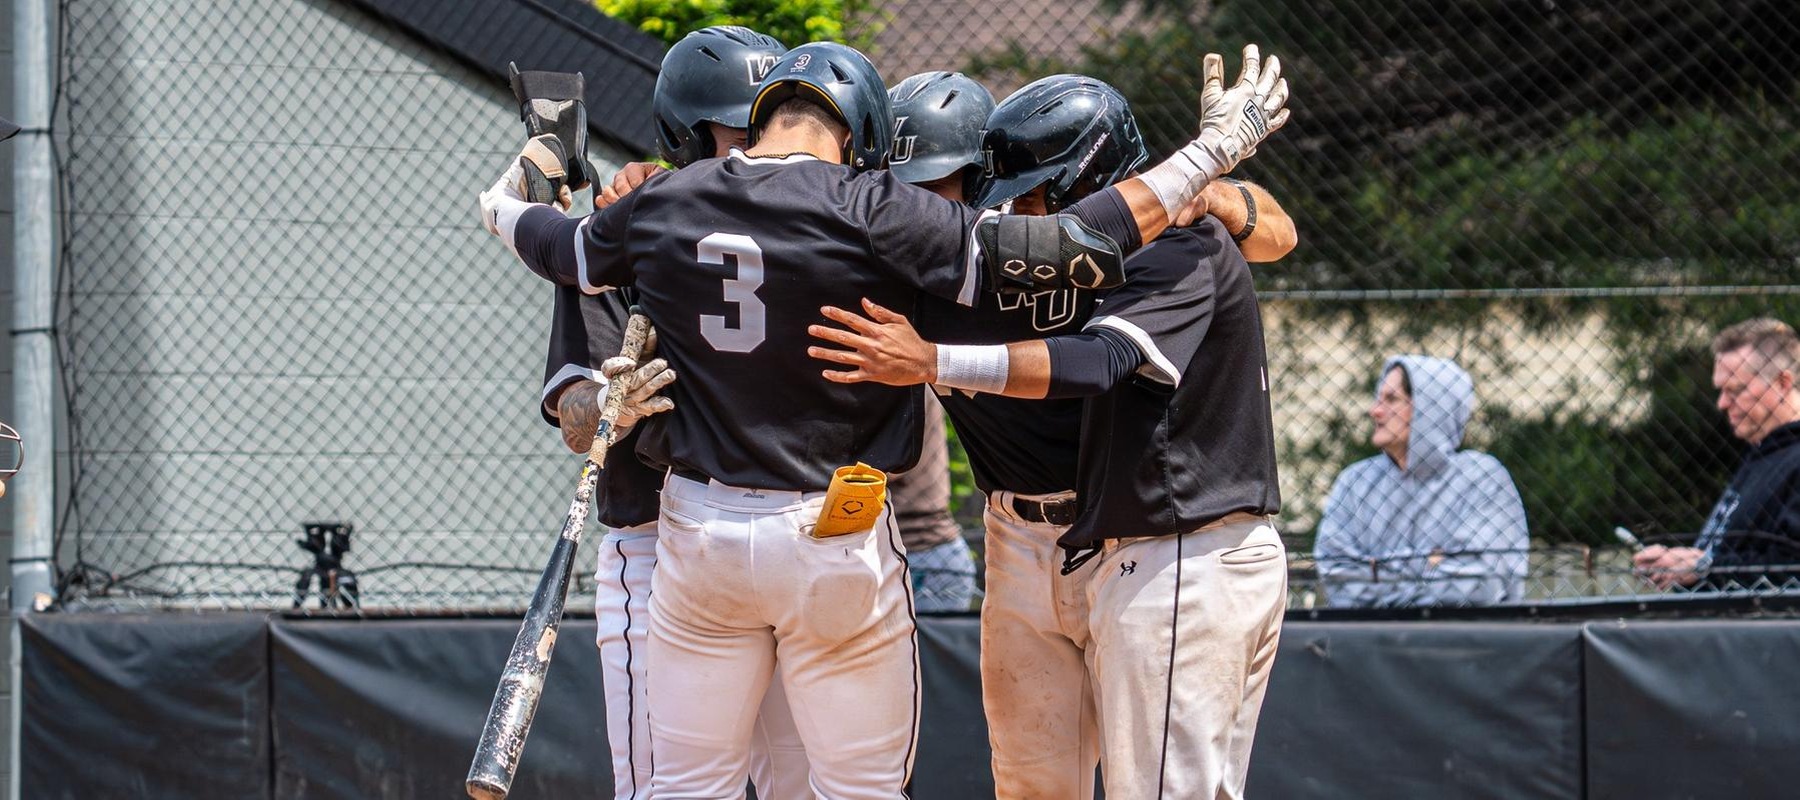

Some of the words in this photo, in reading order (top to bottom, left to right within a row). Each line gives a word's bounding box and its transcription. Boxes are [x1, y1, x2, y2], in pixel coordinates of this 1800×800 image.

[794, 53, 812, 68] 3
[1245, 104, 1266, 136] Franklin
[697, 232, 766, 353] 3
